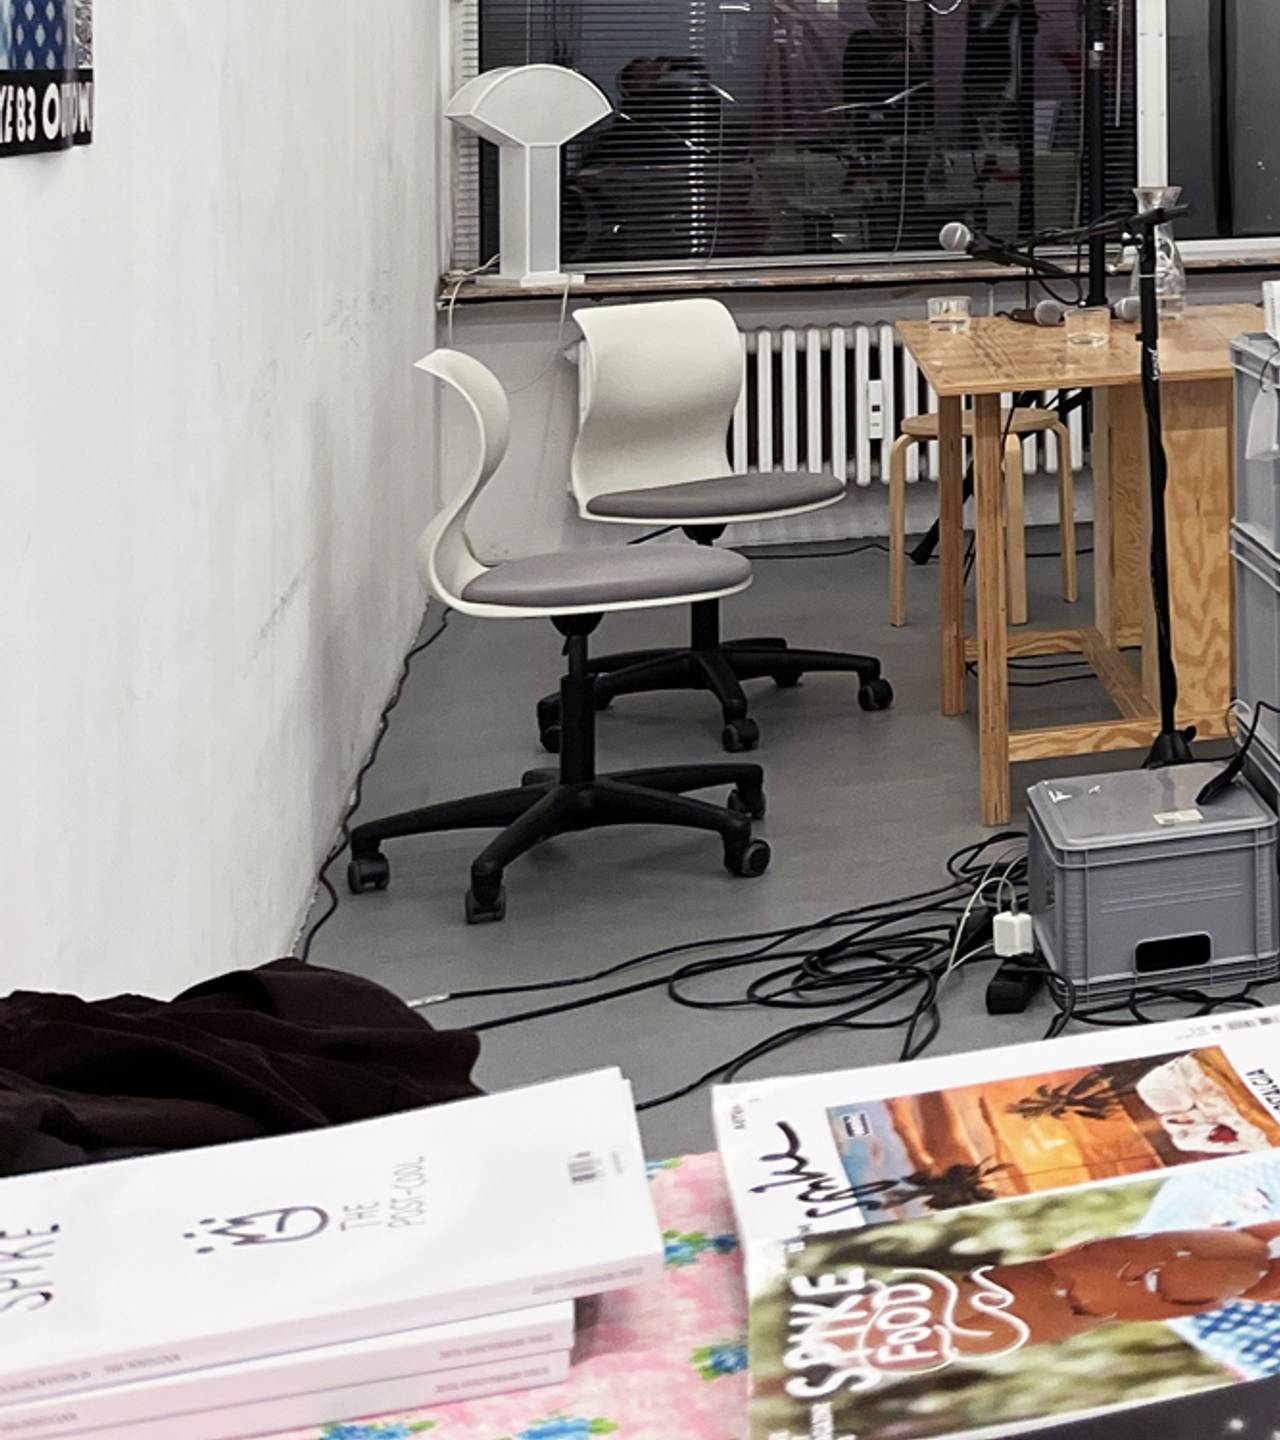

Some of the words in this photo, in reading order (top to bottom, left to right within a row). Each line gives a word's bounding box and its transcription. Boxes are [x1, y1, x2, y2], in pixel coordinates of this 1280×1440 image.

[16, 86, 36, 142] 83
[341, 1200, 380, 1231] THE
[387, 1156, 426, 1228] POST-COOL
[783, 1266, 882, 1398] SPIKE
[871, 1282, 939, 1362] FOOD
